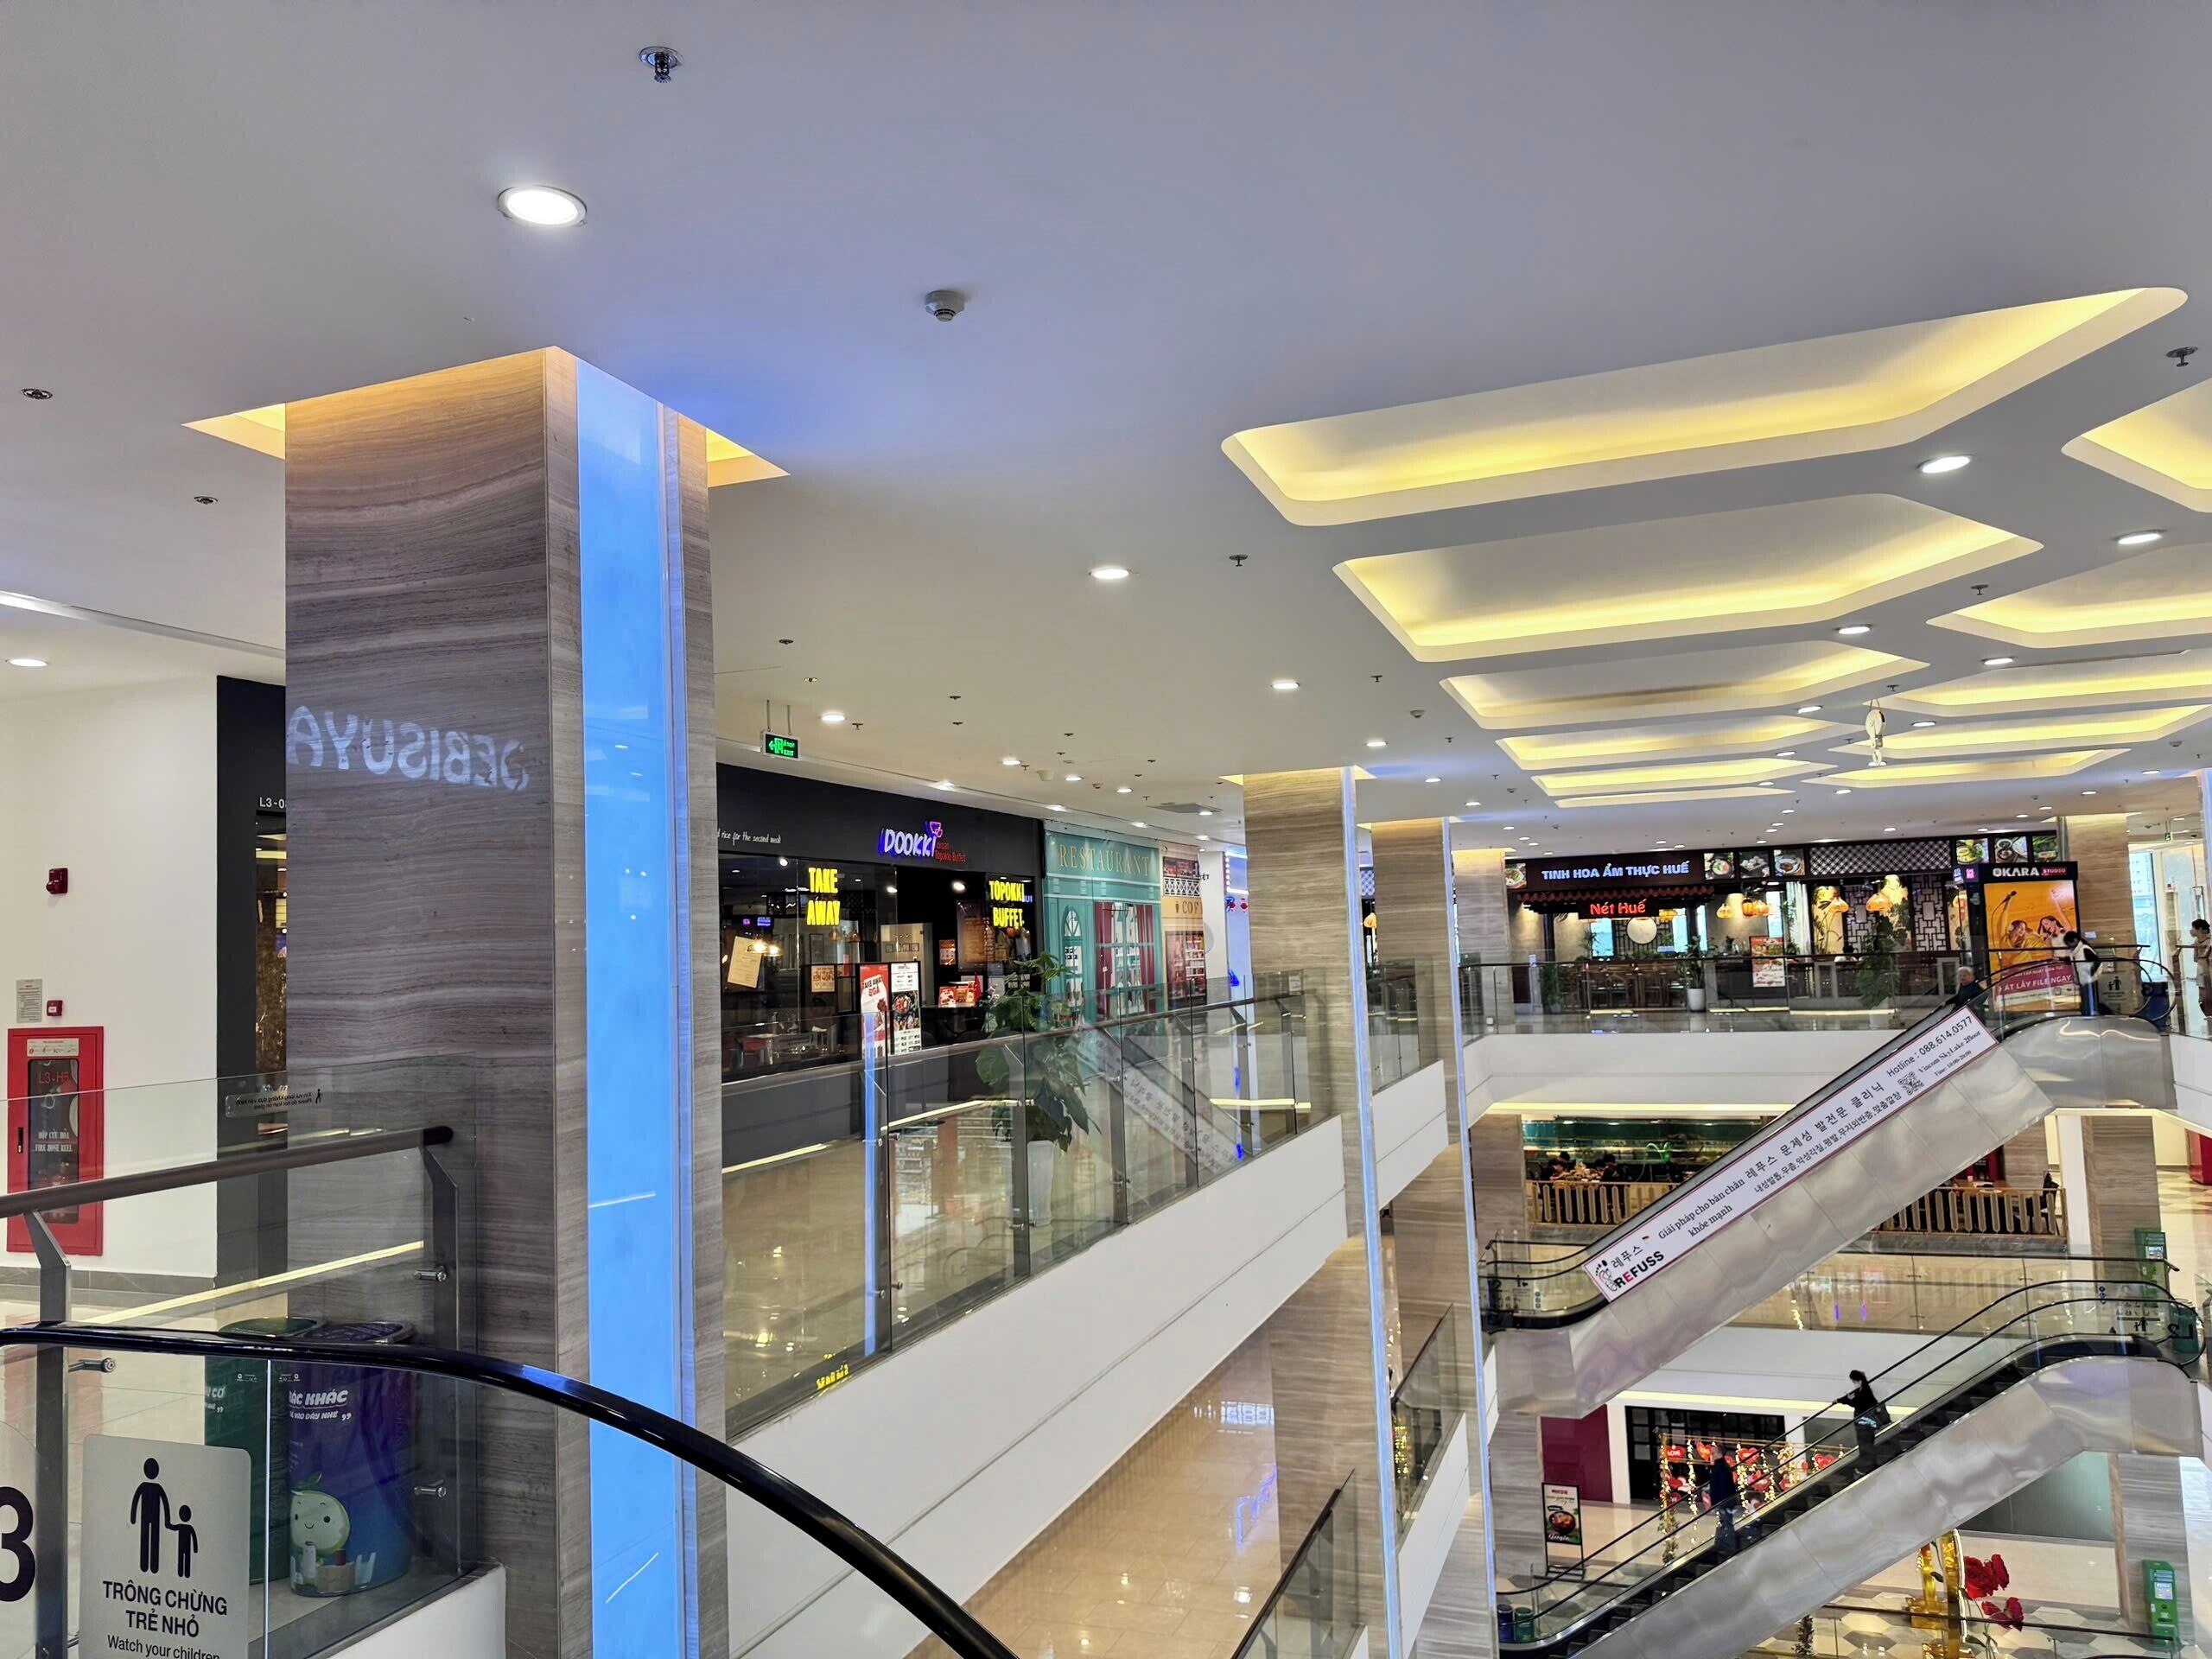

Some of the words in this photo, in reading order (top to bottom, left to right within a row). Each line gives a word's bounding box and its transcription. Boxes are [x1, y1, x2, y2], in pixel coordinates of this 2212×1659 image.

[259, 797, 287, 810] L3-0
[884, 828, 937, 857] DOOKKI
[1059, 844, 1149, 877] RESTAURANT
[1541, 870, 1570, 880] TINH
[1573, 868, 1599, 878] HOA
[1603, 863, 1623, 877] ẨM
[1625, 865, 1660, 878] THỰC
[1663, 861, 1689, 874] HUẾ
[808, 867, 838, 893] TAKE
[1993, 868, 2039, 877] OKARA
[989, 880, 1025, 902] TOPOKKI
[807, 900, 841, 926] AWAY
[993, 907, 1023, 928] BUFFET
[1182, 900, 1203, 914] COF
[1590, 902, 1615, 915] Nét
[1618, 899, 1647, 914] Huế
[2050, 975, 2072, 983] NGAY
[1886, 1055, 1915, 1077] Hotline
[1918, 1015, 1974, 1056] 088.614.0577
[1918, 1058, 1941, 1073] Vincom
[1745, 1155, 1778, 1179] 레푸스
[1780, 1129, 1813, 1157] 문제성
[1815, 1106, 1848, 1133] 발전문
[1851, 1082, 1885, 1109] 클리닉
[1694, 1203, 1710, 1218] cho
[1708, 1205, 1733, 1224] mạnh
[1611, 1245, 1643, 1268] 레푸스
[1613, 1250, 1664, 1288] REFUSS
[305, 1389, 349, 1406] KHÁC
[103, 1580, 161, 1605] TRÔNG
[165, 1588, 228, 1616] CHỪNG
[125, 1608, 158, 1632] TRẺ
[162, 1615, 200, 1638] NHỎ
[107, 1635, 143, 1653] Watch
[145, 1643, 171, 1657] your
